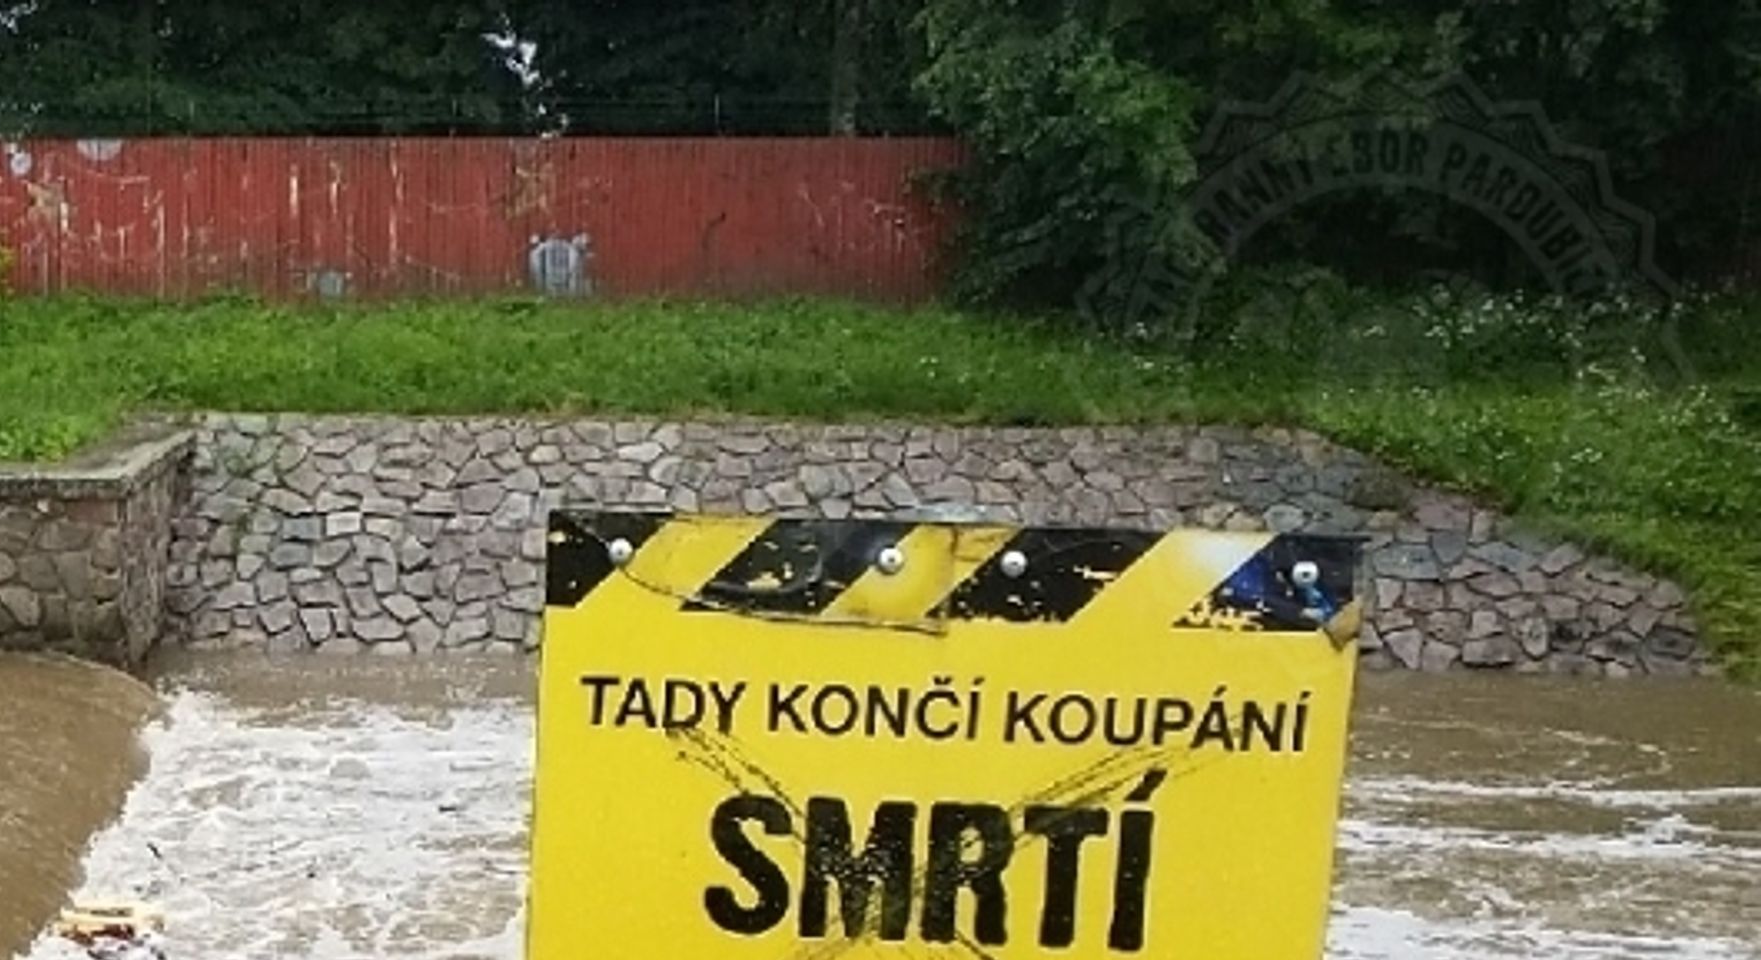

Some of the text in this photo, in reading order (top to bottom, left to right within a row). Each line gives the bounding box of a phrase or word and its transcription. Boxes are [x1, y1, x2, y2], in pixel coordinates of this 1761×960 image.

[581, 676, 1312, 752] TADY KONČÍ KOUPÁNÍ
[704, 767, 1168, 953] SMRTÍ
